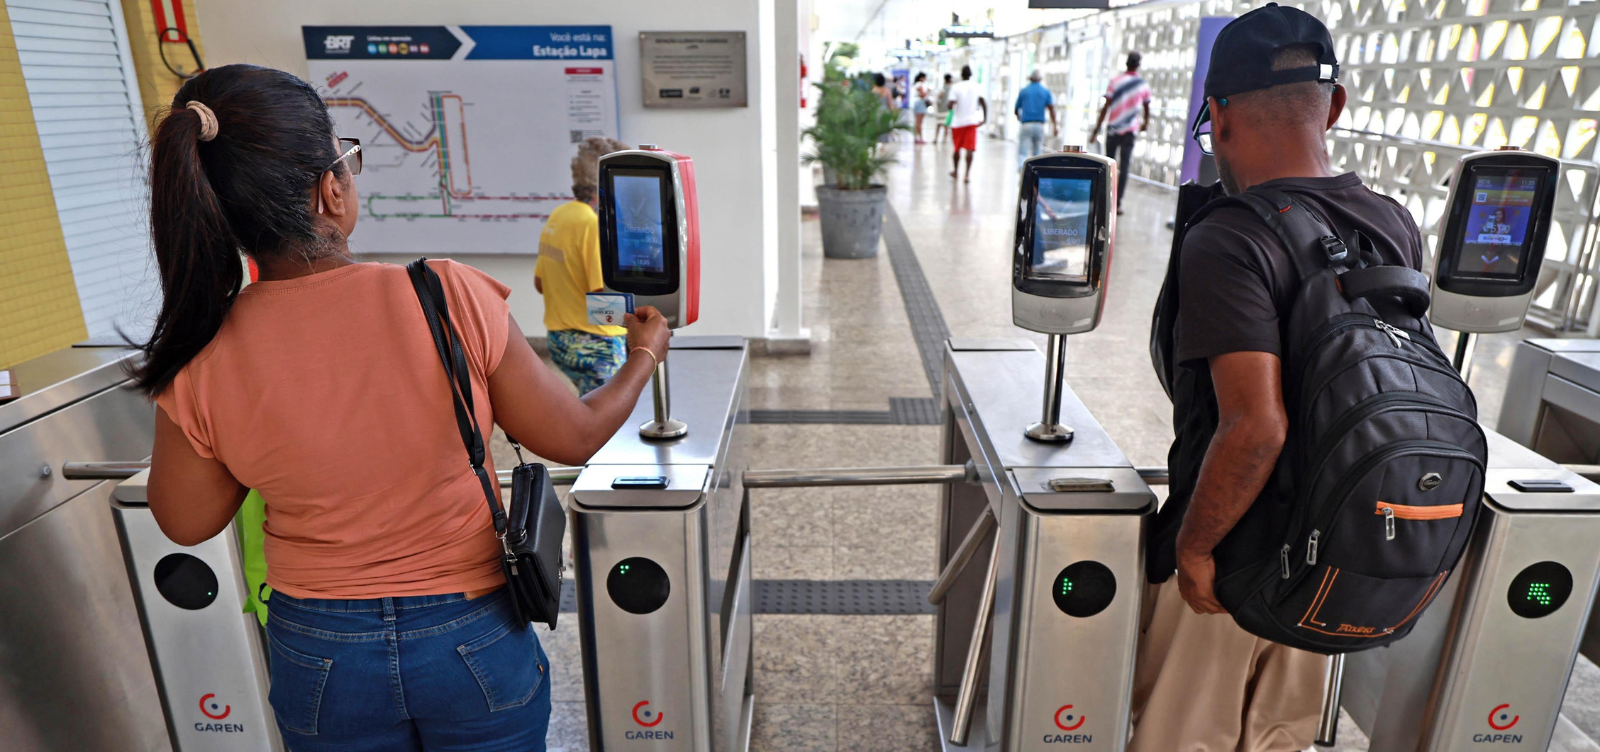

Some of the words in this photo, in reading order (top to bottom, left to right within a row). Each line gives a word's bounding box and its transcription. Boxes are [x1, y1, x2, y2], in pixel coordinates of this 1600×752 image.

[323, 35, 355, 49] BRT
[549, 32, 571, 42] Você
[572, 32, 592, 42] está
[532, 45, 578, 58] Estação
[579, 45, 608, 59] Lapa
[624, 226, 655, 234] LIBERADO
[1043, 228, 1079, 236] LIBERADO
[194, 722, 244, 733] GAREN
[625, 731, 674, 740] GAREN
[1043, 734, 1093, 744] GAREN
